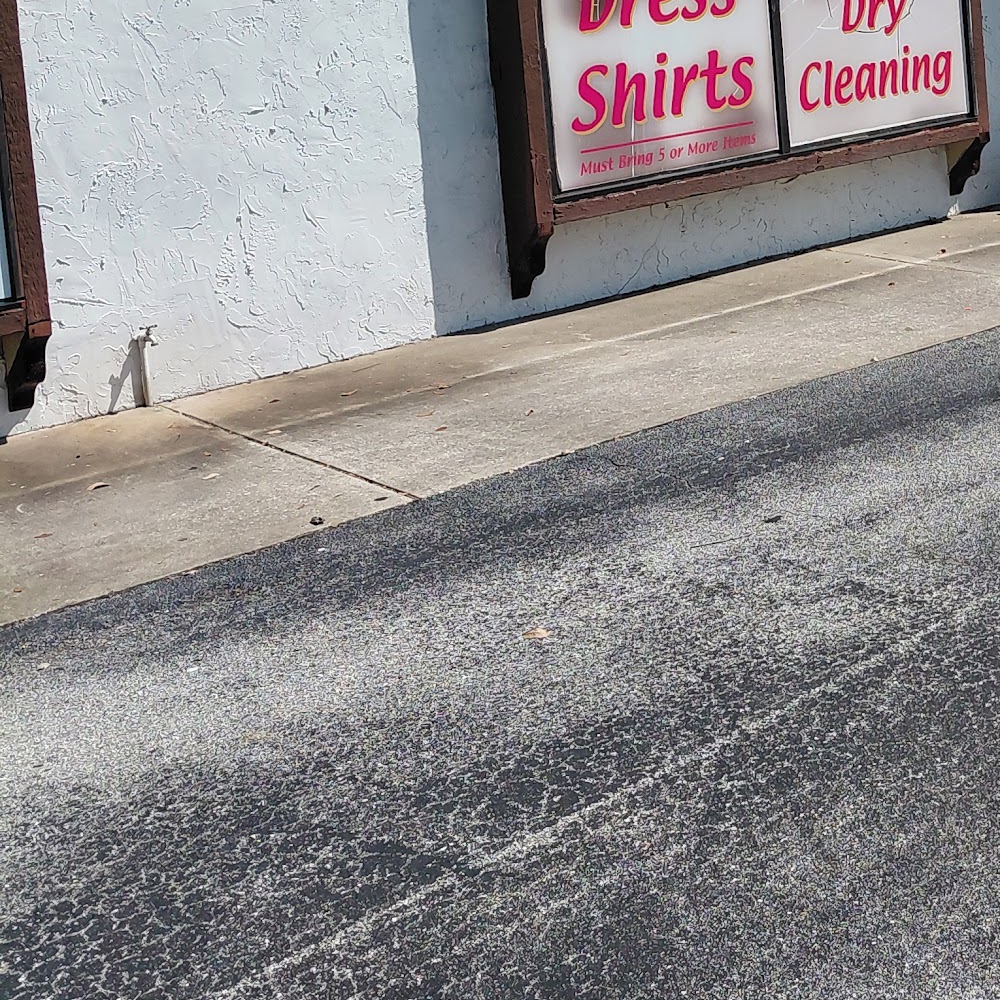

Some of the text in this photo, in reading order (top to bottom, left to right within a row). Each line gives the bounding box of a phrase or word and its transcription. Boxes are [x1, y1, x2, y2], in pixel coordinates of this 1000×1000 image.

[571, 49, 755, 134] Shirts
[799, 45, 953, 113] Cleaning
[580, 132, 757, 177] Must Bring 5 or More Items
